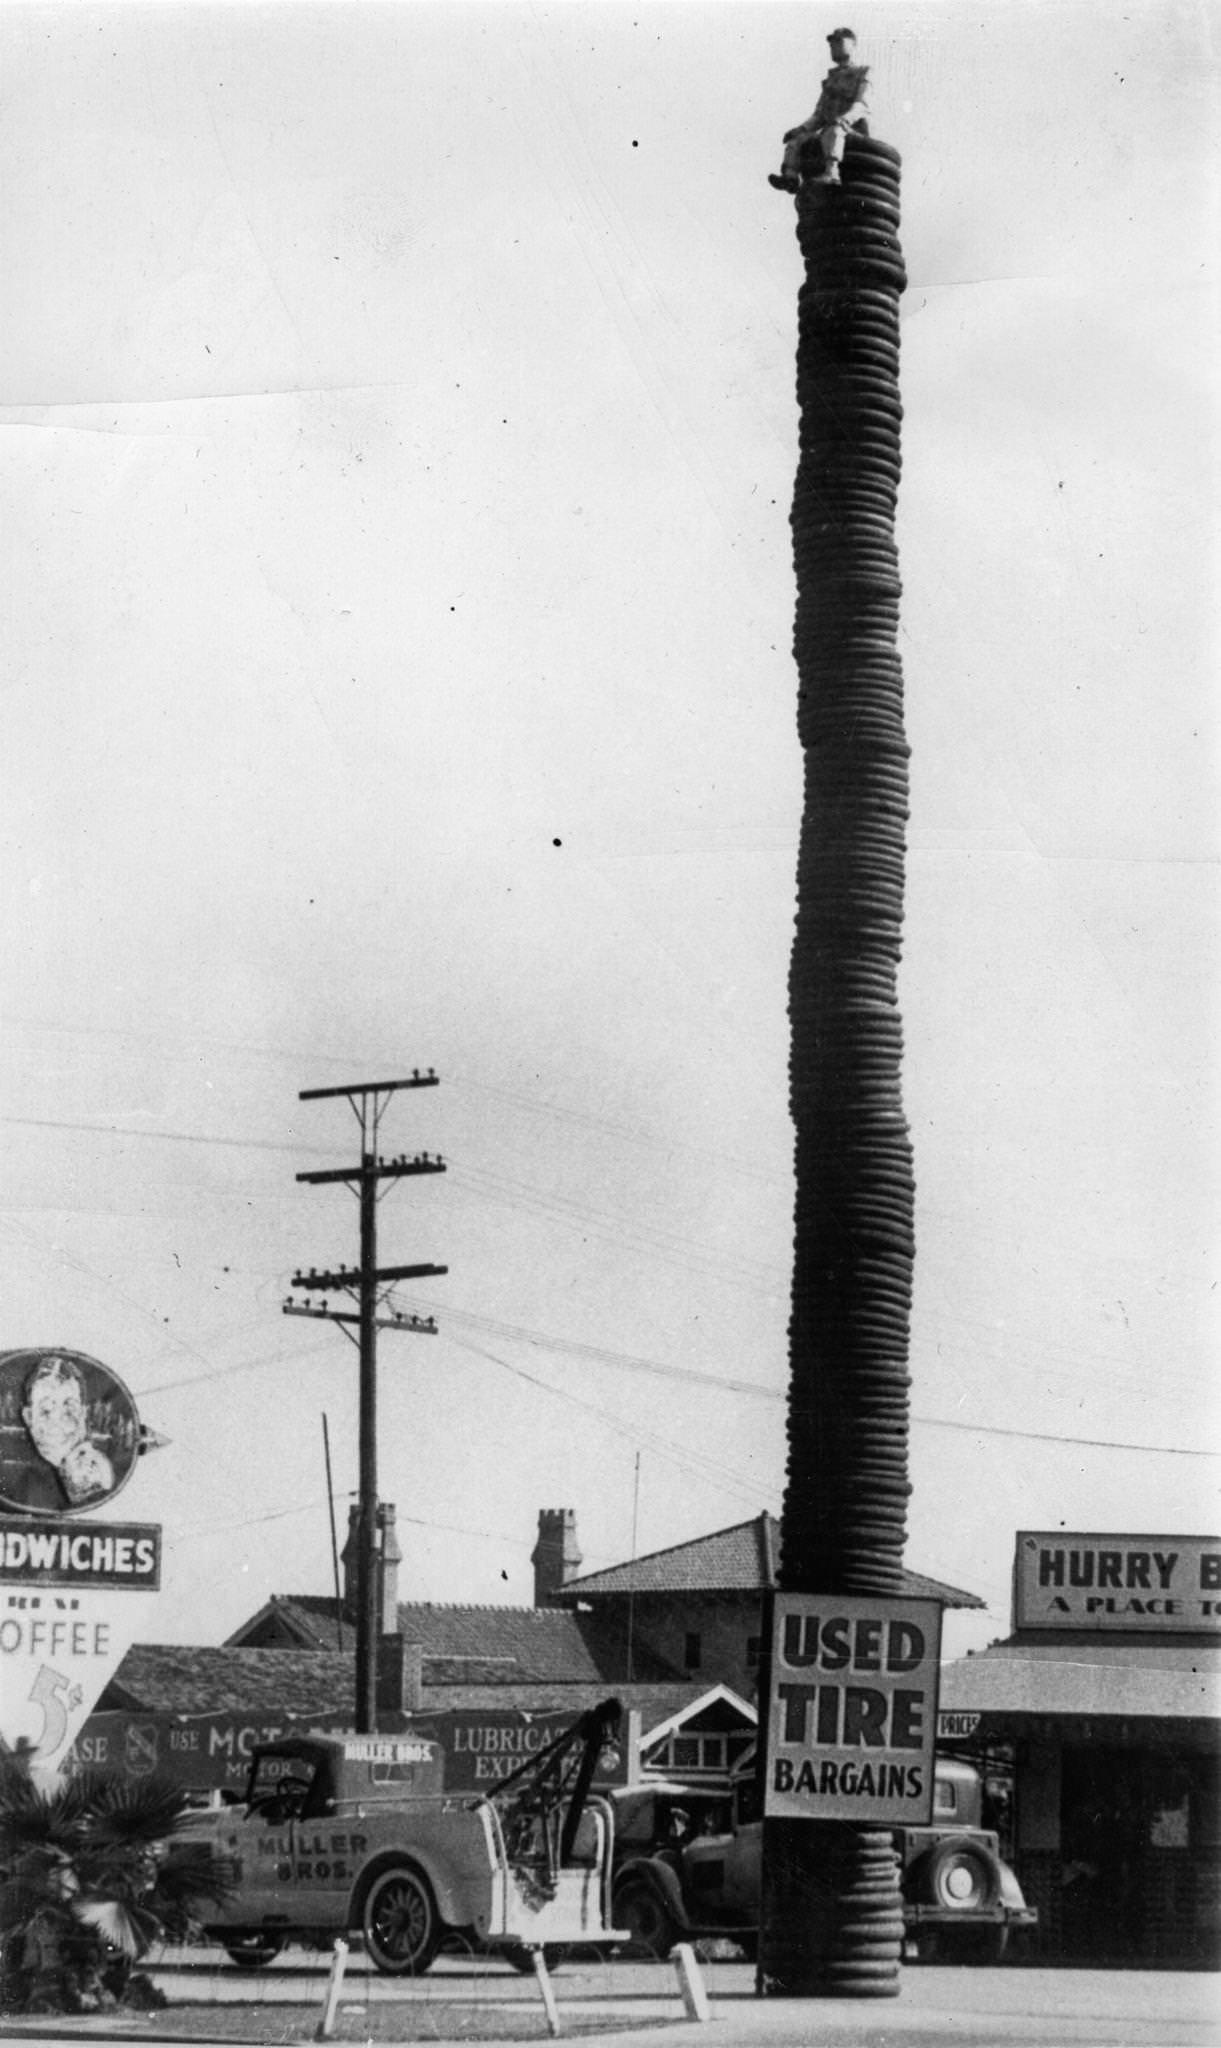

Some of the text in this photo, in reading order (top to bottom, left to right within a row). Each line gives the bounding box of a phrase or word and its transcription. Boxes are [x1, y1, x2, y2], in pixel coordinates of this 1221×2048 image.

[0, 1532, 154, 1573] DWICHES
[1039, 1549, 1179, 1589] HURRY
[1048, 1596, 1071, 1613] A
[1086, 1597, 1184, 1615] PLACE
[783, 1614, 925, 1672] USED
[778, 1683, 925, 1750] TIRE
[170, 1731, 200, 1750] USE
[344, 1742, 393, 1761] MULLER
[774, 1758, 923, 1798] BARGAINS
[257, 1834, 368, 1856] MULLER
